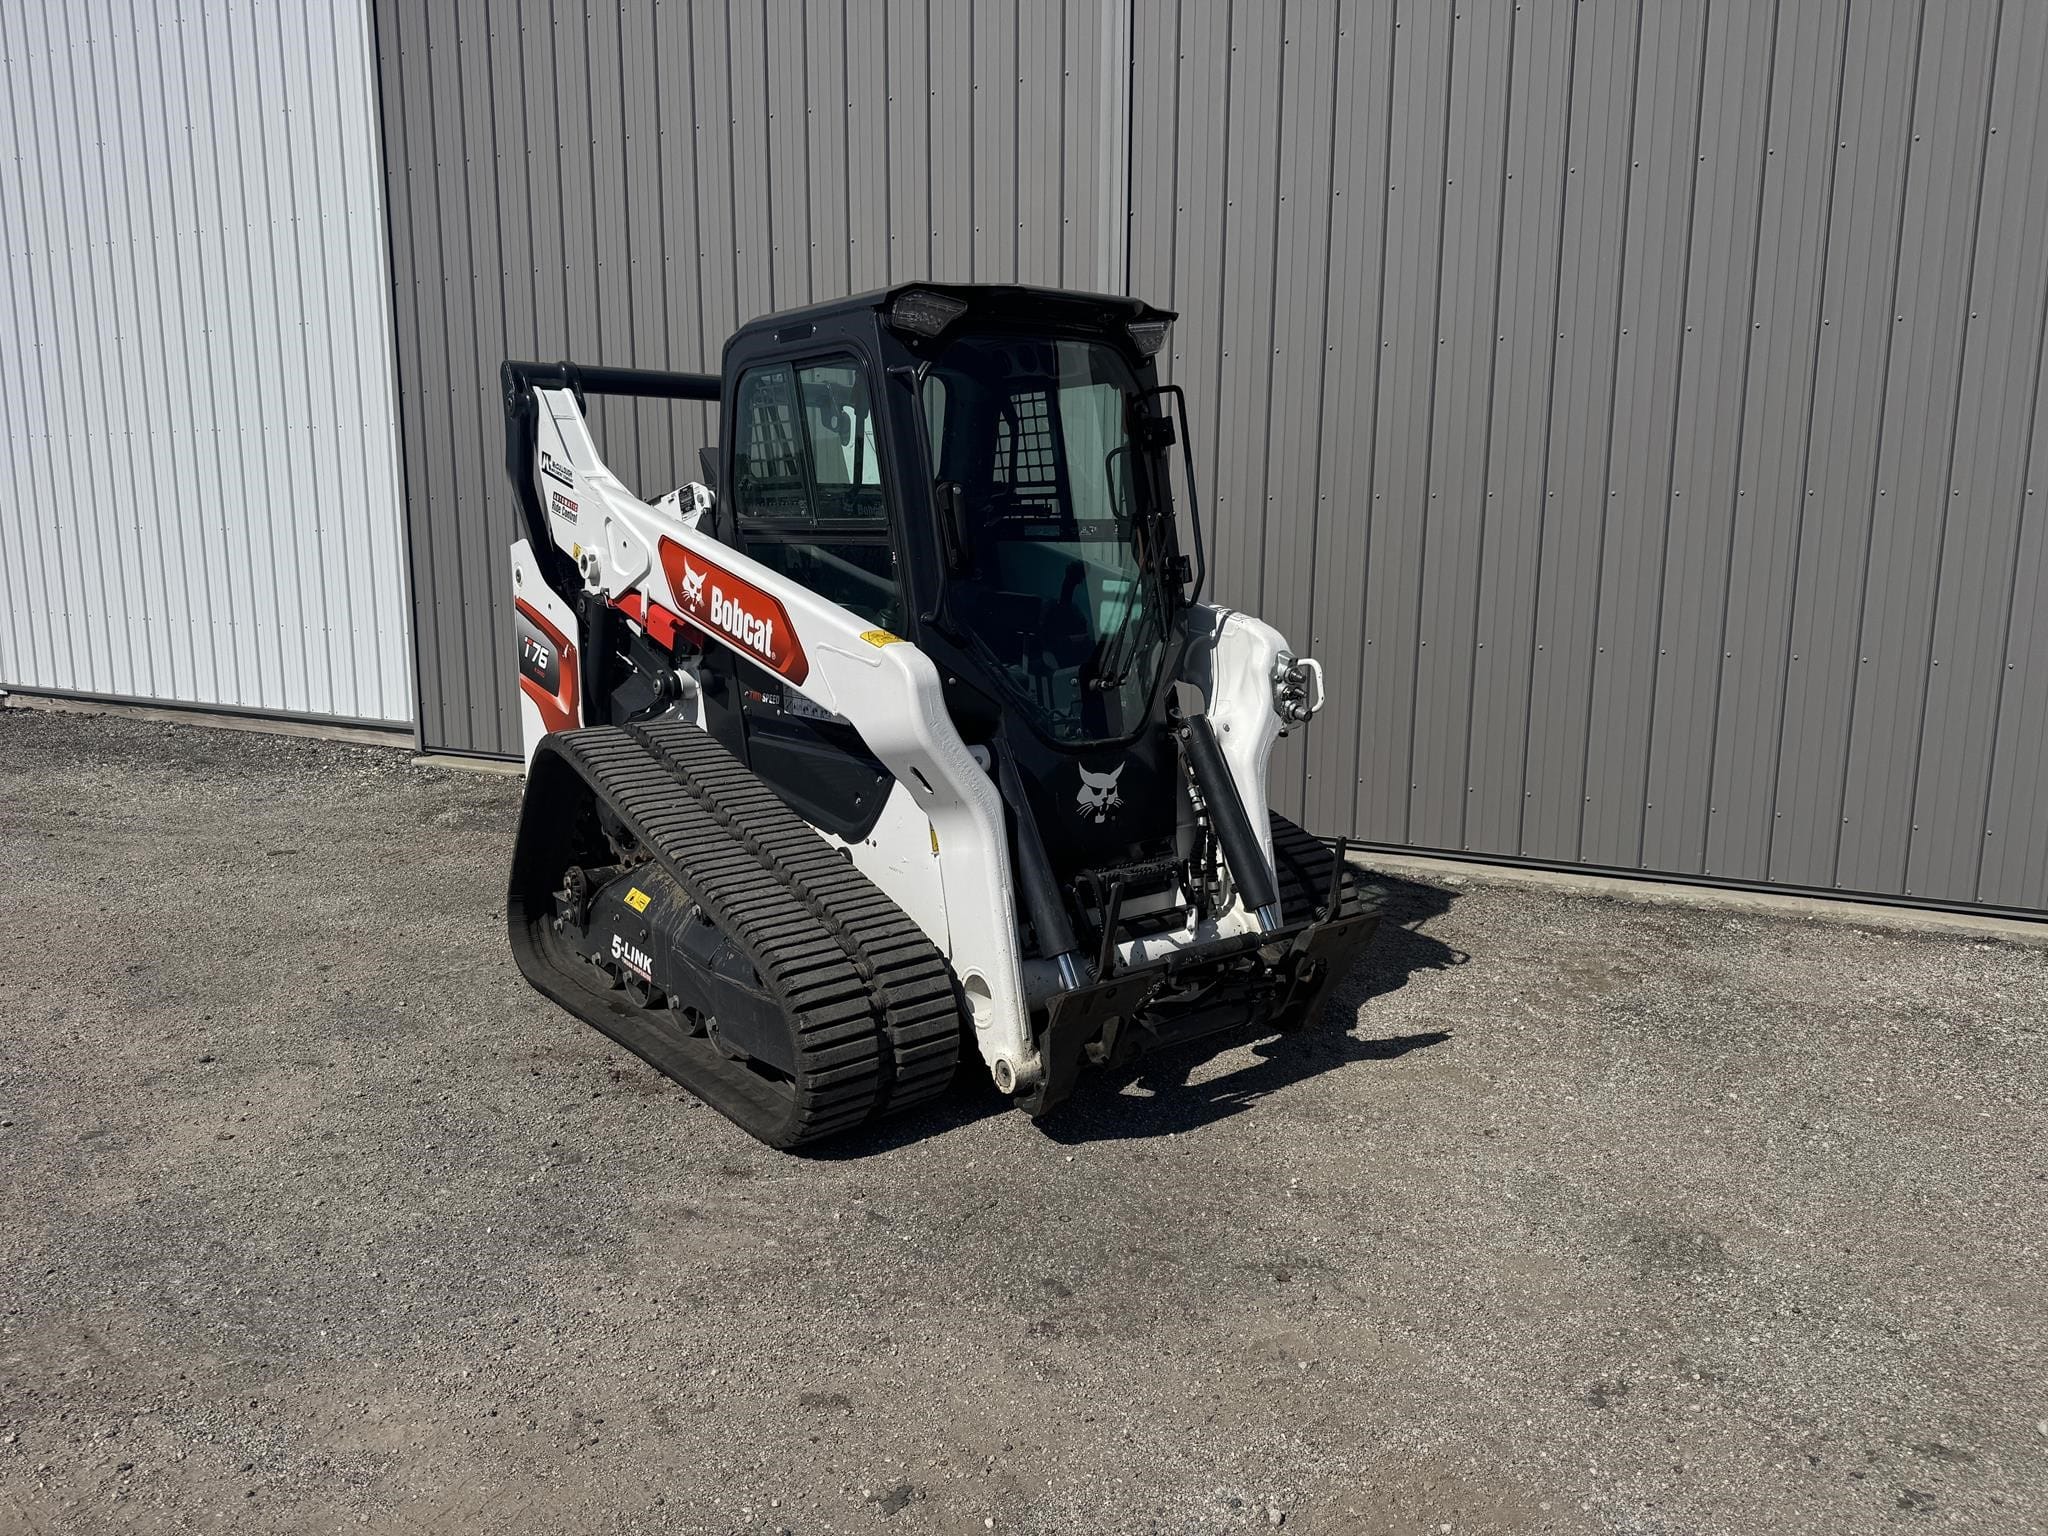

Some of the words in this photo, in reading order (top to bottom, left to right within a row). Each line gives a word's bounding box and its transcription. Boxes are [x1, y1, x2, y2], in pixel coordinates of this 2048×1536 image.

[561, 506, 578, 523] Control
[711, 585, 773, 658] Bobcat
[524, 636, 550, 669] T76
[611, 933, 653, 975] 5-LINK
